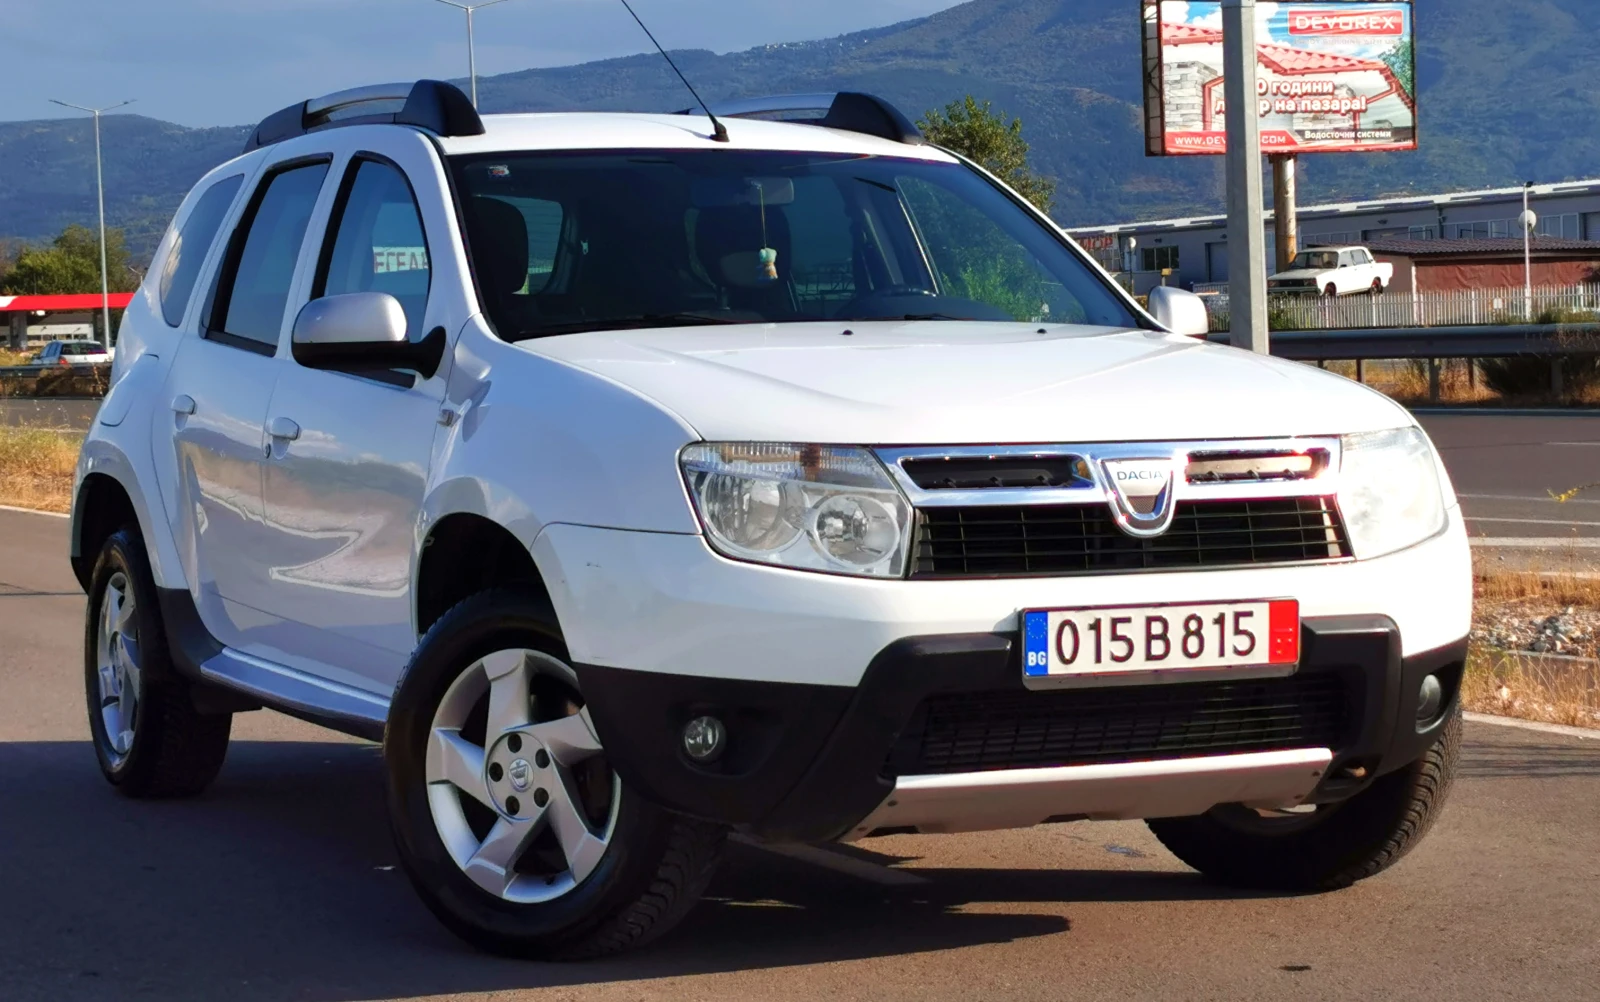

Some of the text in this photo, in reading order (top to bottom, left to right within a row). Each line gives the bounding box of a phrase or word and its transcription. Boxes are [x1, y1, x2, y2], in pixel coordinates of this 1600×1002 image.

[1295, 16, 1396, 30] DEVOREX
[1272, 80, 1334, 97] години
[1275, 99, 1297, 112] на
[1301, 95, 1367, 115] пазара!
[1304, 130, 1392, 140] Водосточни системи
[1117, 470, 1164, 481] DACIA
[1027, 650, 1047, 667] BG
